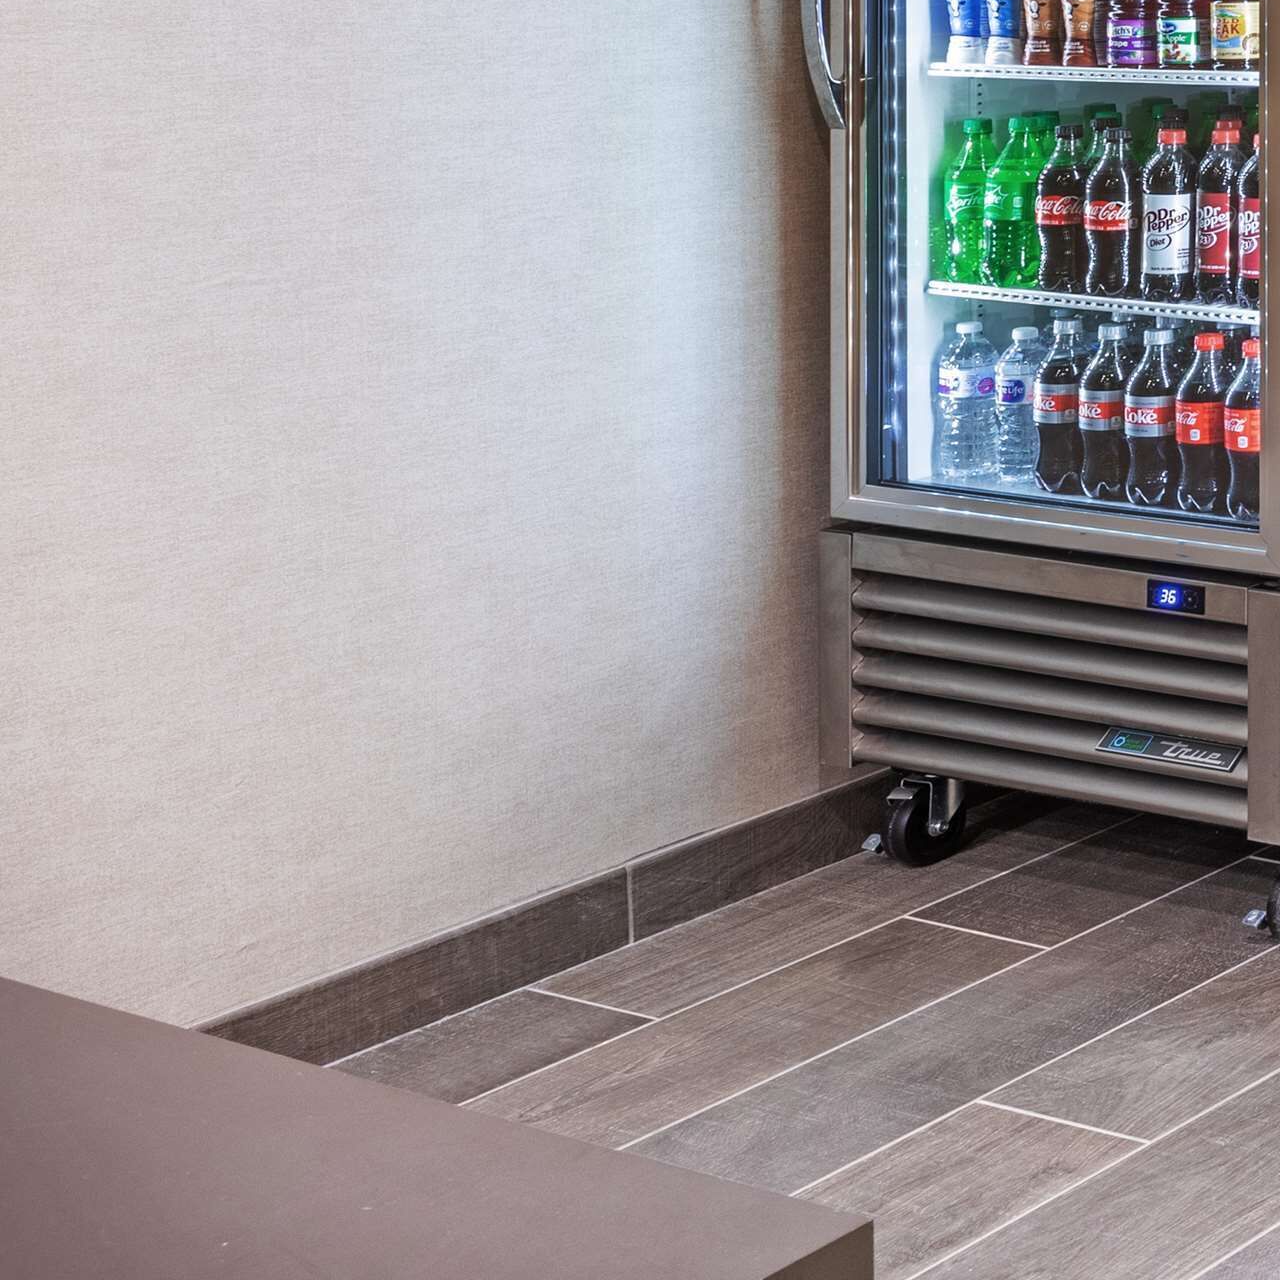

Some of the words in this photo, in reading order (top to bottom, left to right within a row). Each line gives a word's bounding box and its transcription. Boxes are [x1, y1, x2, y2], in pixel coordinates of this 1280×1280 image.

[1159, 208, 1176, 219] Dr
[1204, 205, 1221, 218] Dr
[1145, 210, 1188, 232] Pepper
[1125, 408, 1158, 425] Coke
[1160, 589, 1176, 604] 36
